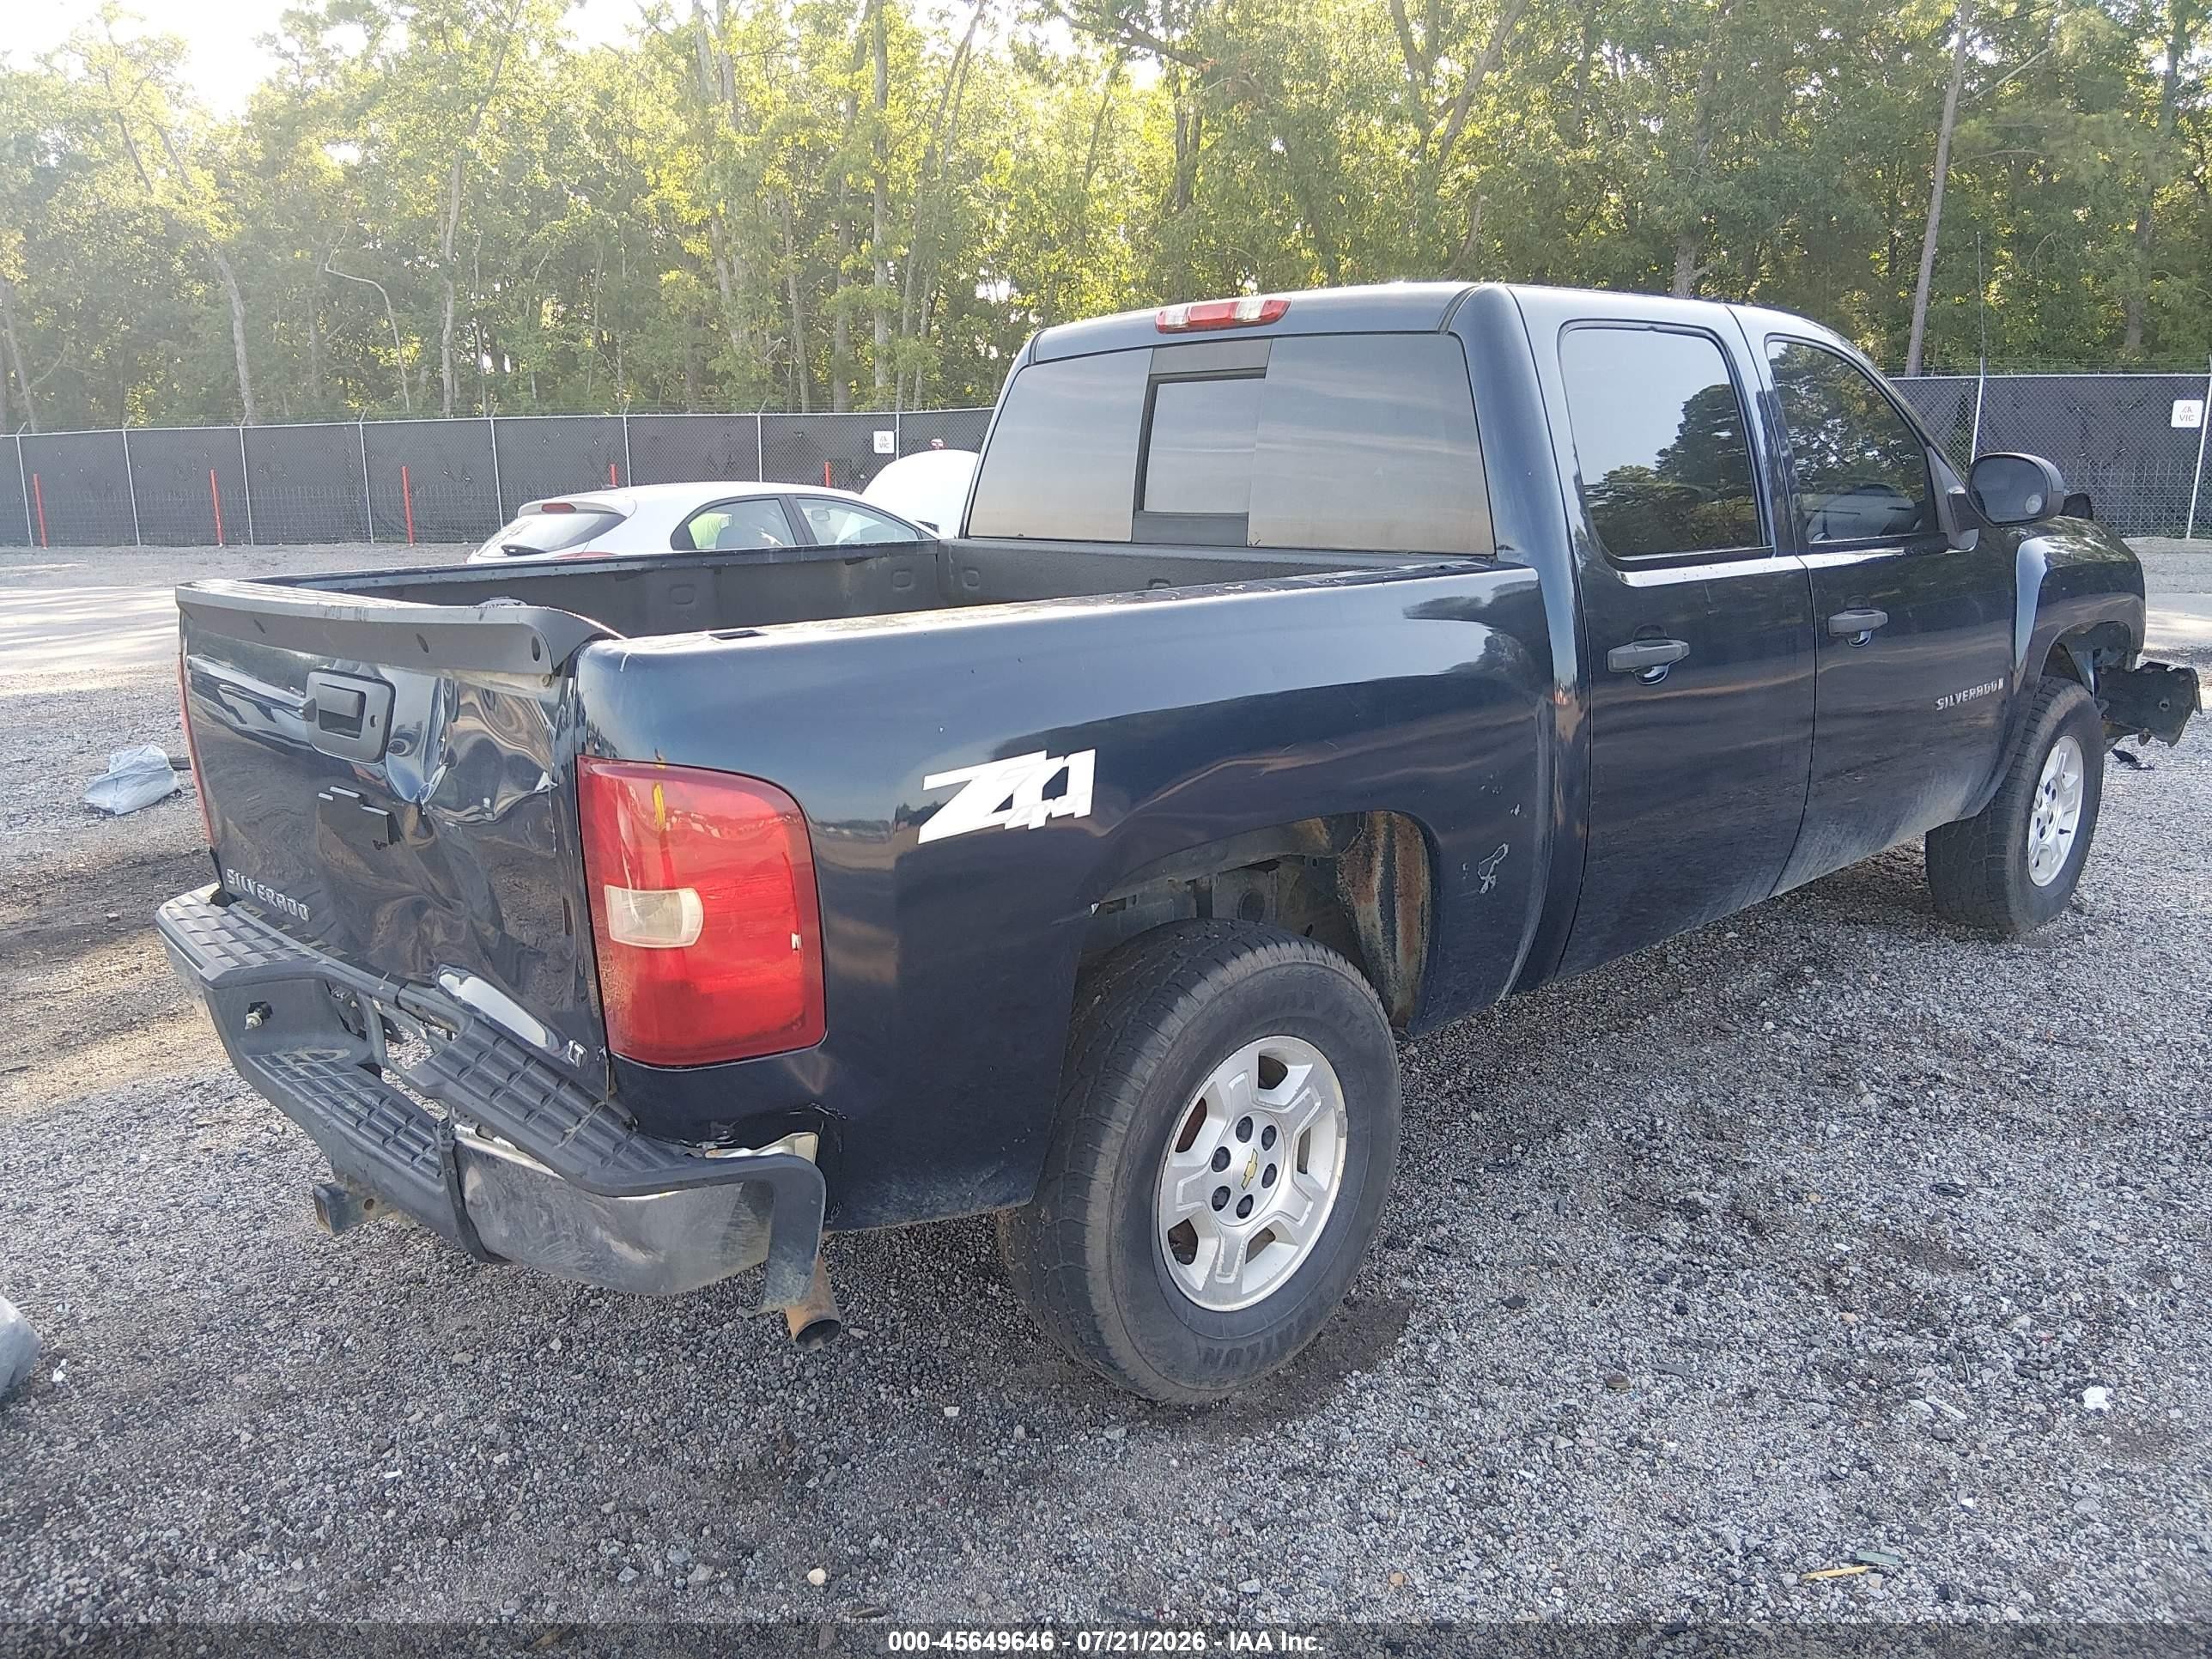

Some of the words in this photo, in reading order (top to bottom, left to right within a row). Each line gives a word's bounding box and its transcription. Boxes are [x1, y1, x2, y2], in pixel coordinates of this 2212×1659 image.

[1936, 680, 1997, 711] SILVERADO
[917, 749, 1096, 845] Z71
[226, 868, 310, 921] SILVERADO
[568, 1040, 585, 1067] LT
